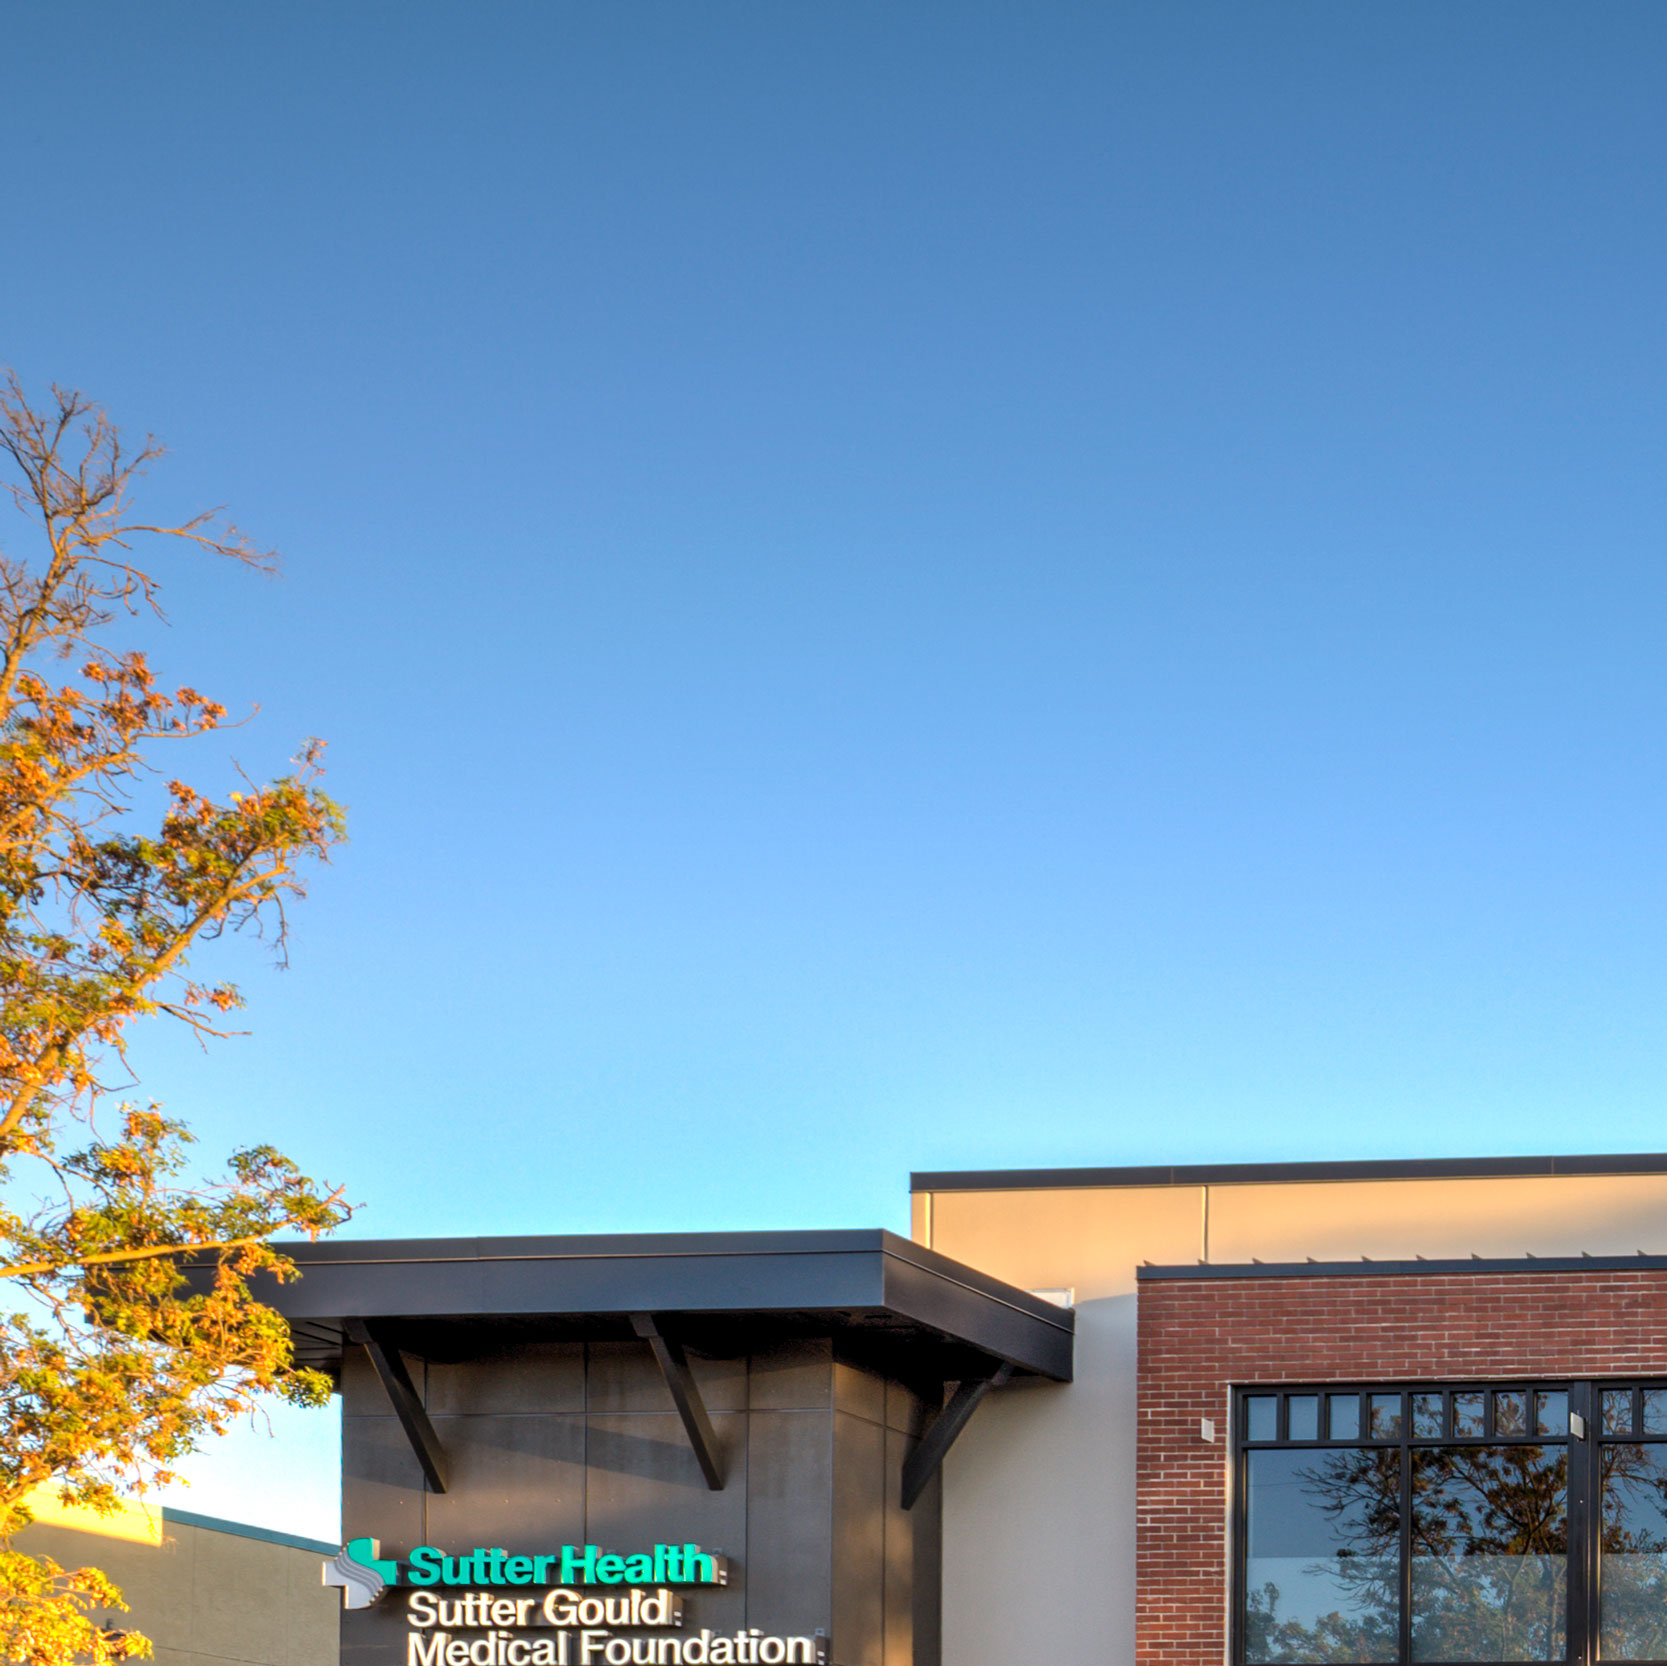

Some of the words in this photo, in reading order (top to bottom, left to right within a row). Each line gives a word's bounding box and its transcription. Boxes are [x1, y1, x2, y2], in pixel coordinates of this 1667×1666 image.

[408, 1546, 555, 1585] Sutter
[561, 1544, 714, 1584] Health
[407, 1590, 535, 1627] Sutter
[544, 1589, 668, 1626] Gould
[407, 1630, 567, 1666] Medical
[581, 1629, 812, 1666] Foundation
